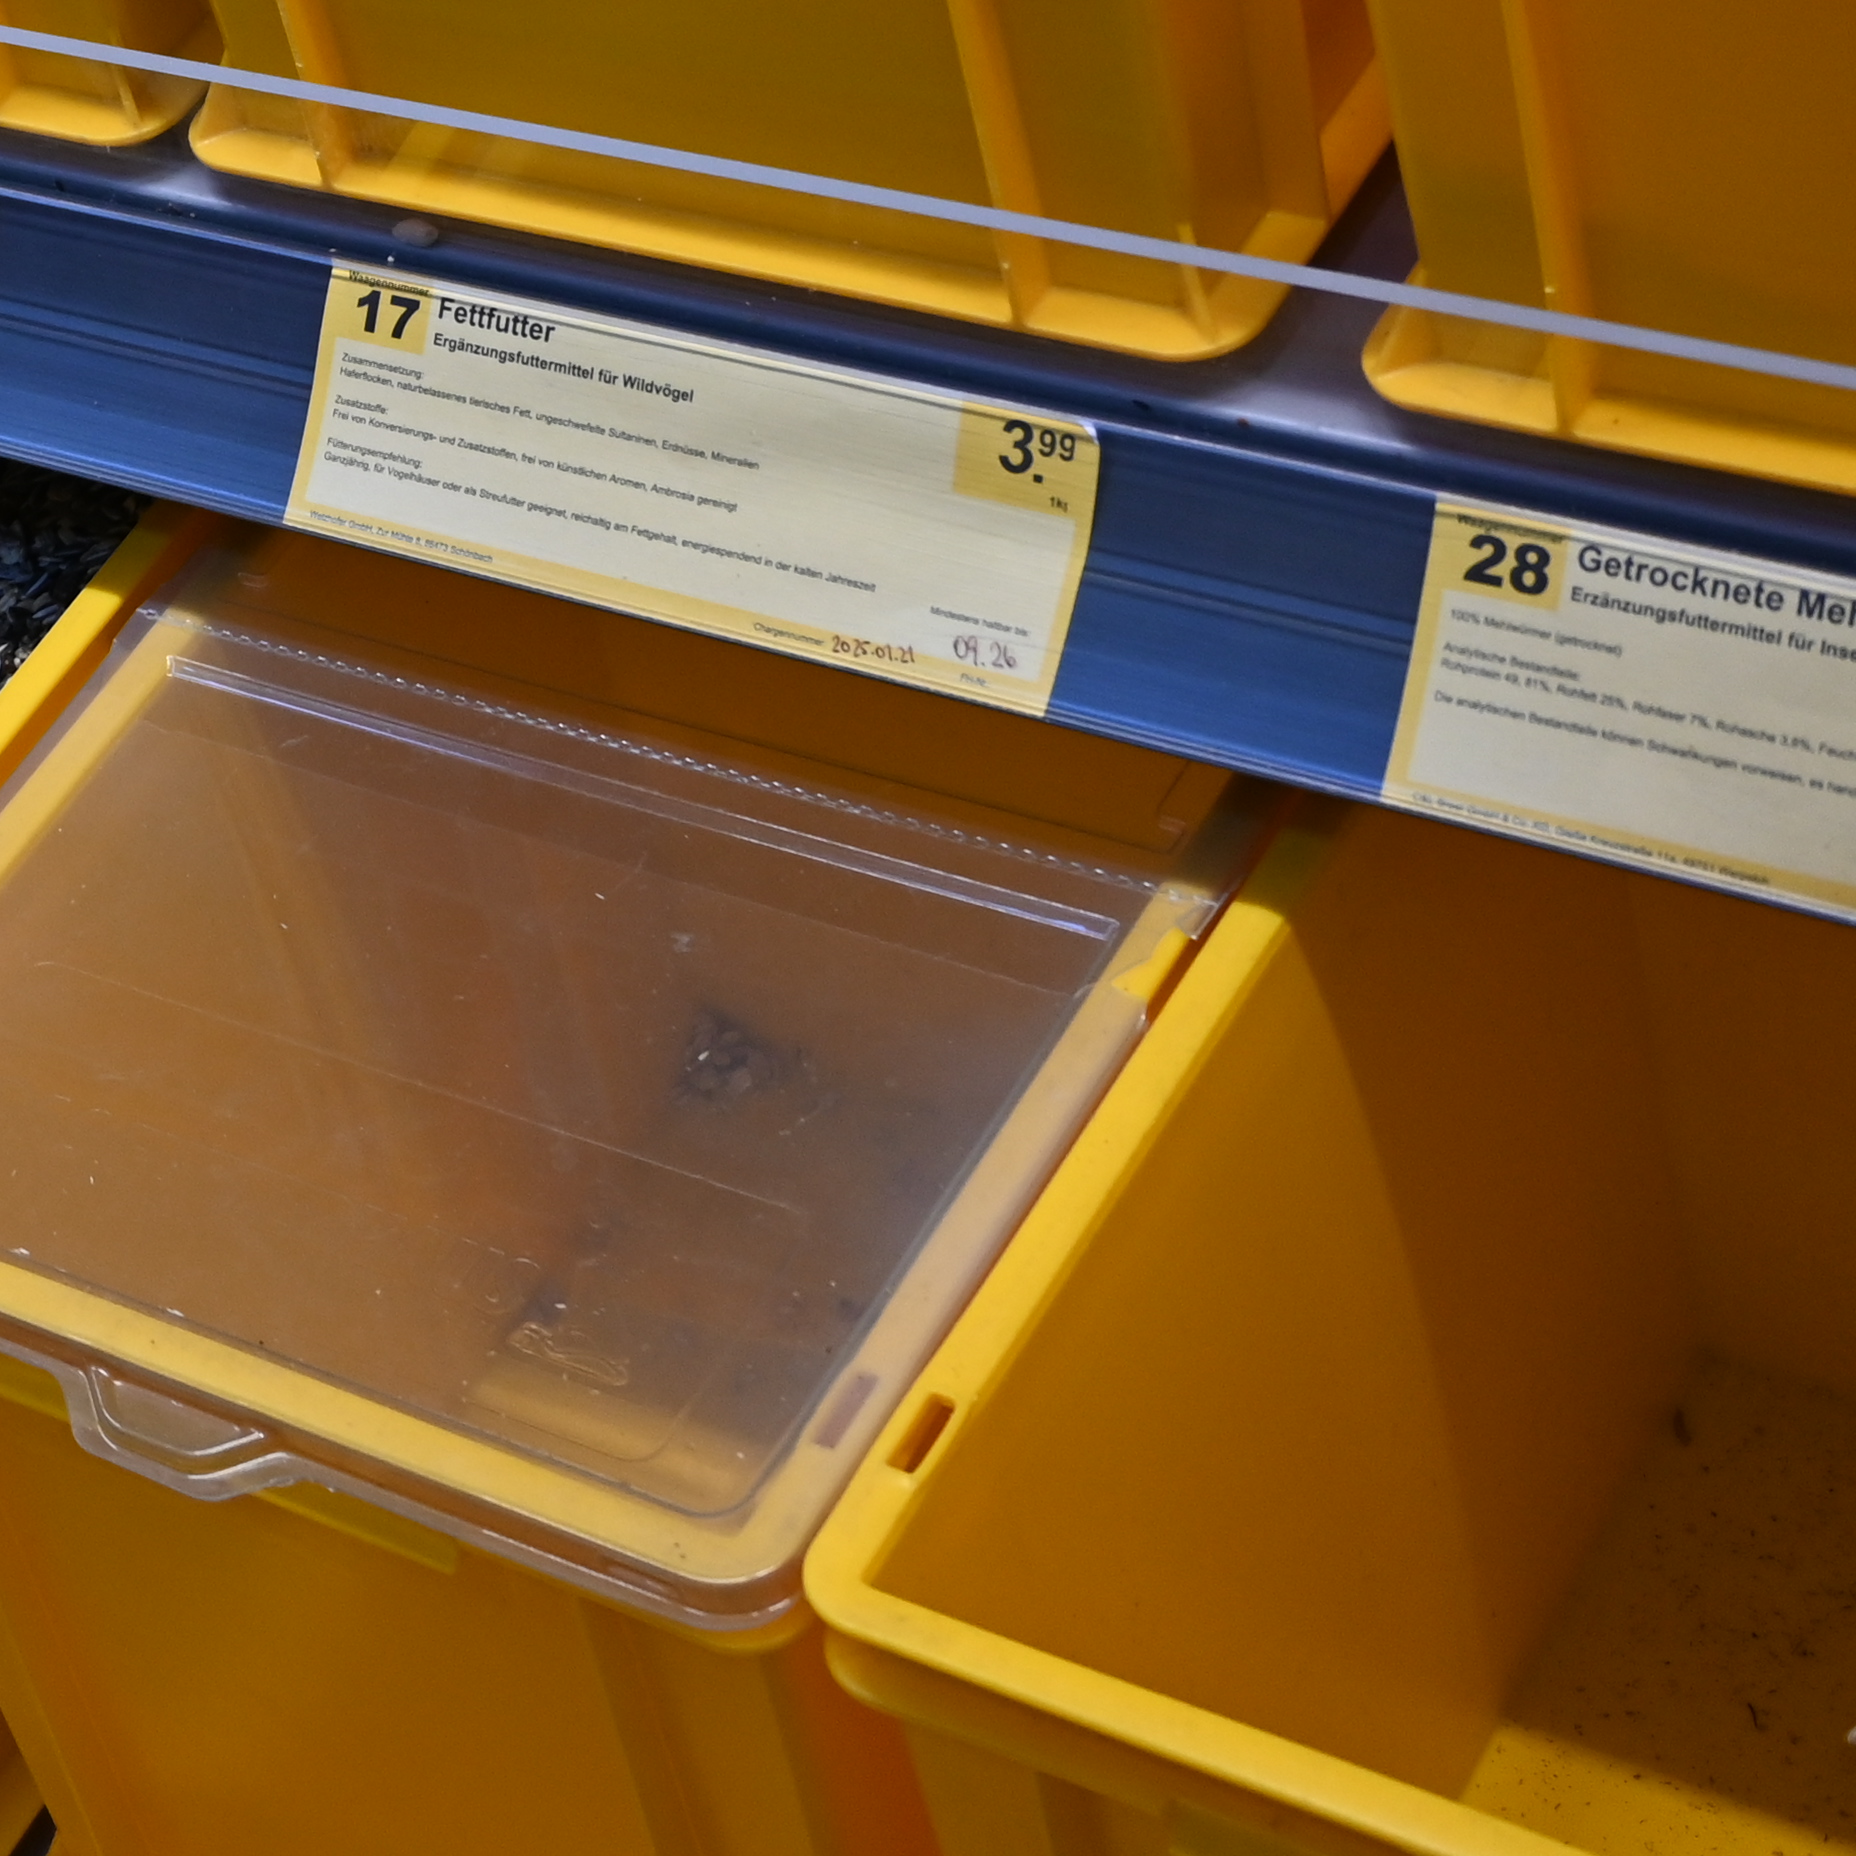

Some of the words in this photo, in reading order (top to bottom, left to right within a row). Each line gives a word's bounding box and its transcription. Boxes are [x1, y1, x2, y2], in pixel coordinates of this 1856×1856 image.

[357, 289, 421, 339] 17
[437, 297, 555, 342] Fettfutter
[342, 353, 423, 379] Zusammensetzung:
[433, 332, 594, 380] Ergänzungsfuttermittel
[598, 369, 619, 385] für
[623, 373, 694, 402] Wildvögel
[335, 396, 388, 415] Zusatzstoffe:
[339, 366, 395, 389] Haferflocken,
[397, 379, 466, 403] naturbelassenes
[469, 395, 510, 414] tierisches
[513, 406, 532, 420] Fett,
[536, 412, 605, 436] ungeschwefelte
[608, 427, 658, 449] Sultaninen,
[662, 440, 707, 459] Erdnüsse,
[711, 451, 759, 470] Mineralien
[327, 437, 422, 468] Fütterungsempfehlung:
[332, 408, 349, 420] Frei
[351, 416, 366, 425] von
[439, 434, 455, 445] und
[457, 438, 518, 461] Zusatzstoffen,
[521, 453, 536, 465] frei
[538, 459, 554, 469] von
[556, 461, 607, 481] künstlichen
[609, 473, 647, 492] Aromen,
[650, 483, 694, 502] Ambrosia
[697, 495, 737, 513] gereinigt
[998, 419, 1076, 484] 3.99
[324, 451, 370, 472] Ganzjährig,
[373, 463, 385, 474] für
[387, 465, 440, 487] Vogelhäuser
[442, 480, 462, 493] oder
[464, 486, 477, 496] als
[479, 488, 525, 508] Streufutter
[527, 500, 568, 519] geeignet,
[614, 522, 628, 532] am
[630, 525, 678, 546] Fettgehalt,
[682, 538, 762, 565] energiespendend
[764, 556, 773, 567] in
[775, 560, 791, 571] der
[794, 563, 822, 579] kalten
[825, 573, 876, 592] Jahreszeit
[1463, 534, 1551, 595] 28
[1578, 545, 1784, 612] Getrocknete
[1788, 631, 1814, 651] für
